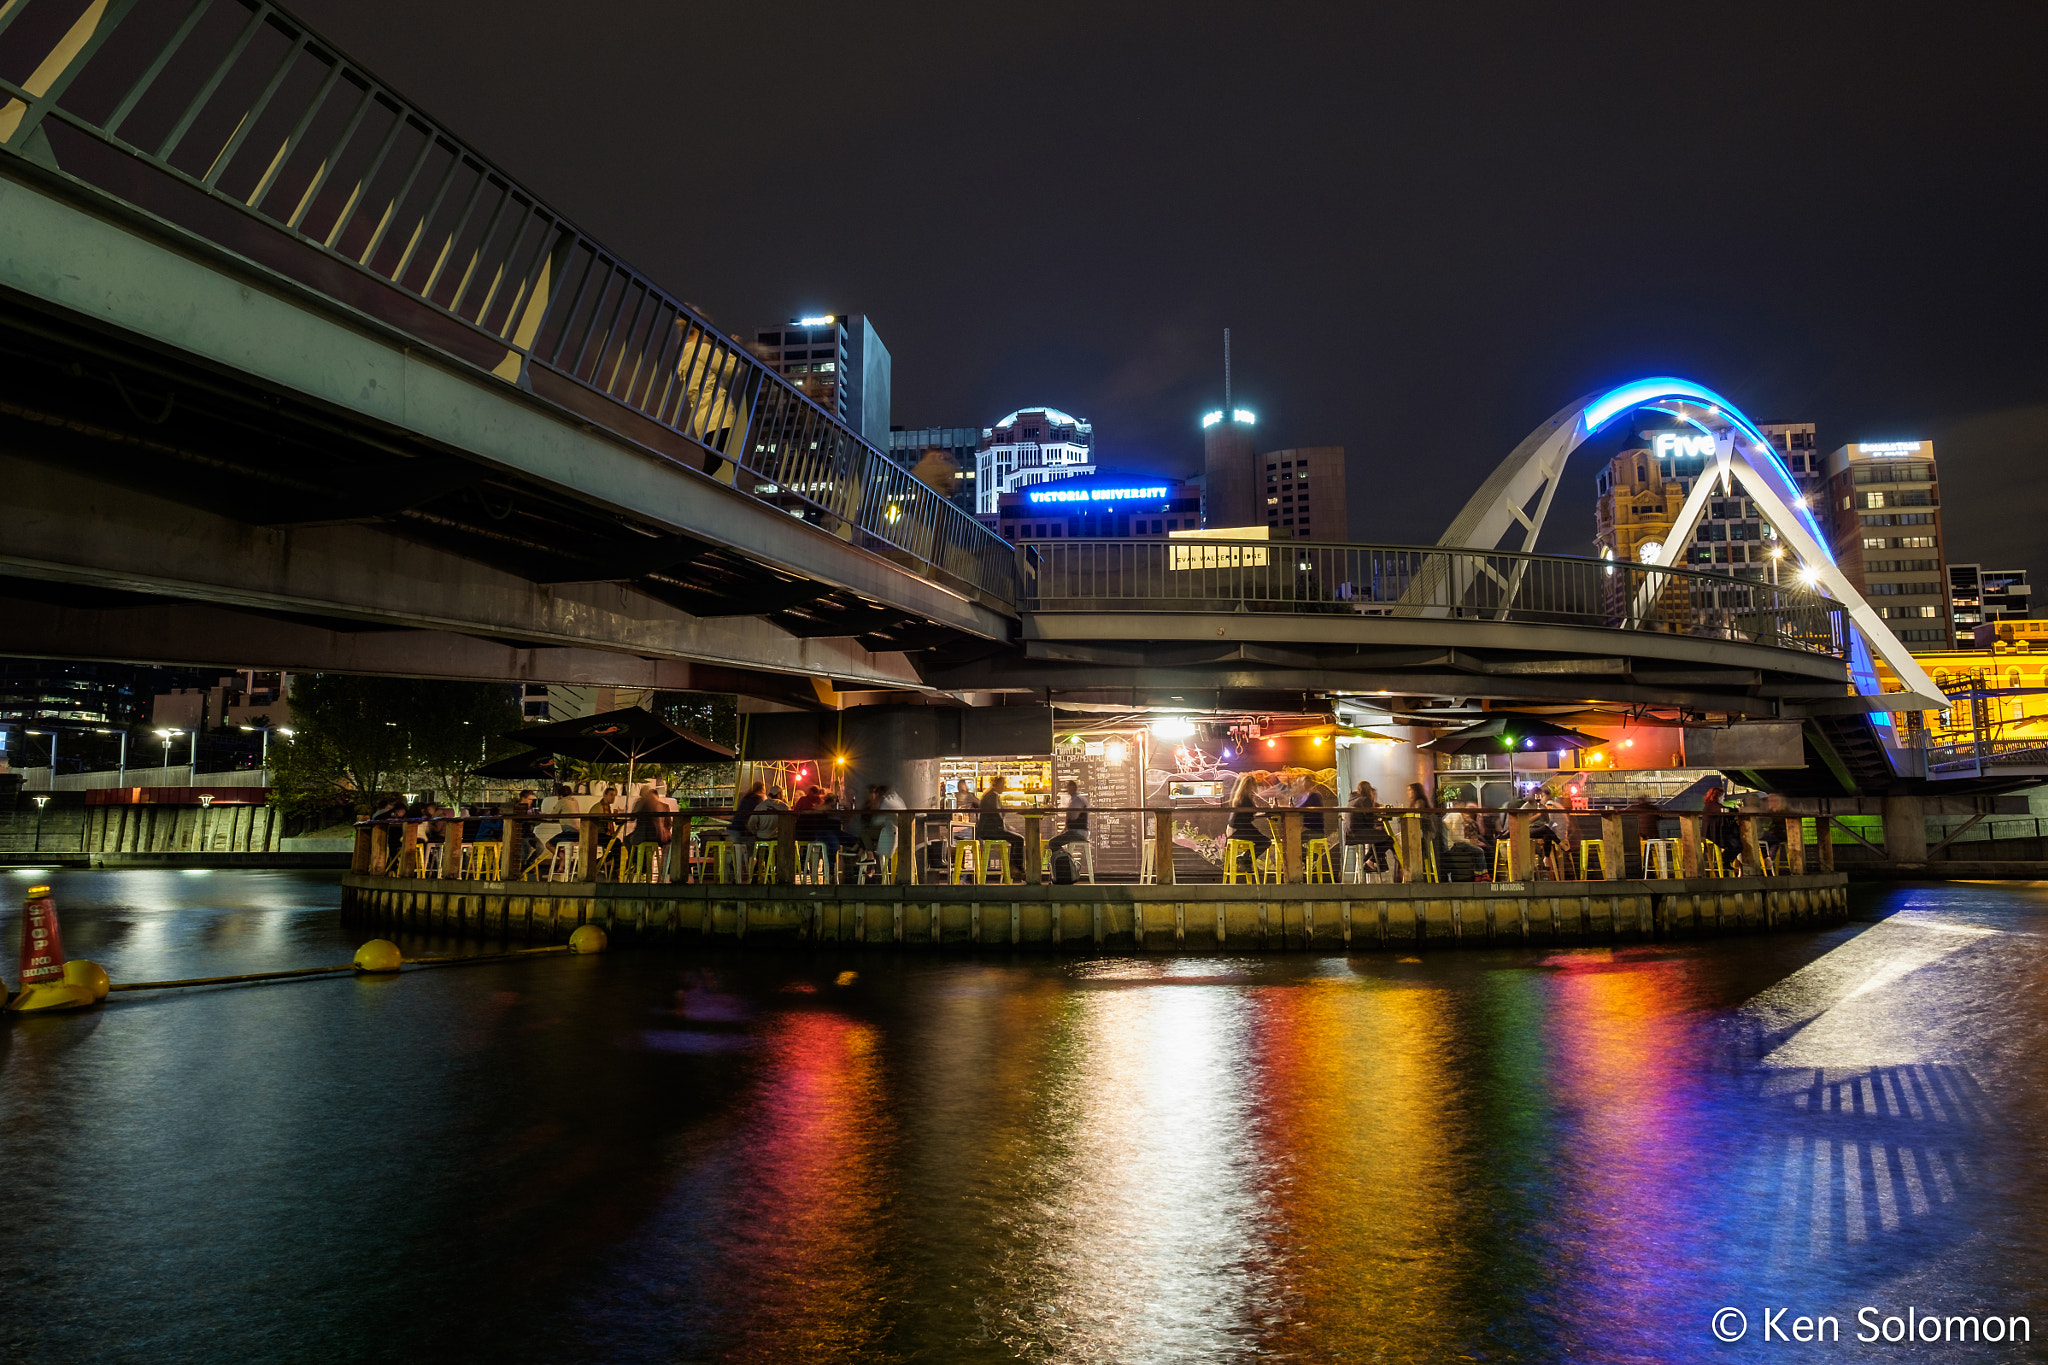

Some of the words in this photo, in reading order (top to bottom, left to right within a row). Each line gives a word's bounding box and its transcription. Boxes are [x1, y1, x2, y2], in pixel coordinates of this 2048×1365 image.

[1030, 490, 1089, 503] VICTORIA
[1091, 487, 1167, 500] UNIVERSITY
[29, 904, 49, 951] STOP
[31, 956, 51, 966] NO
[23, 965, 62, 978] BOATS
